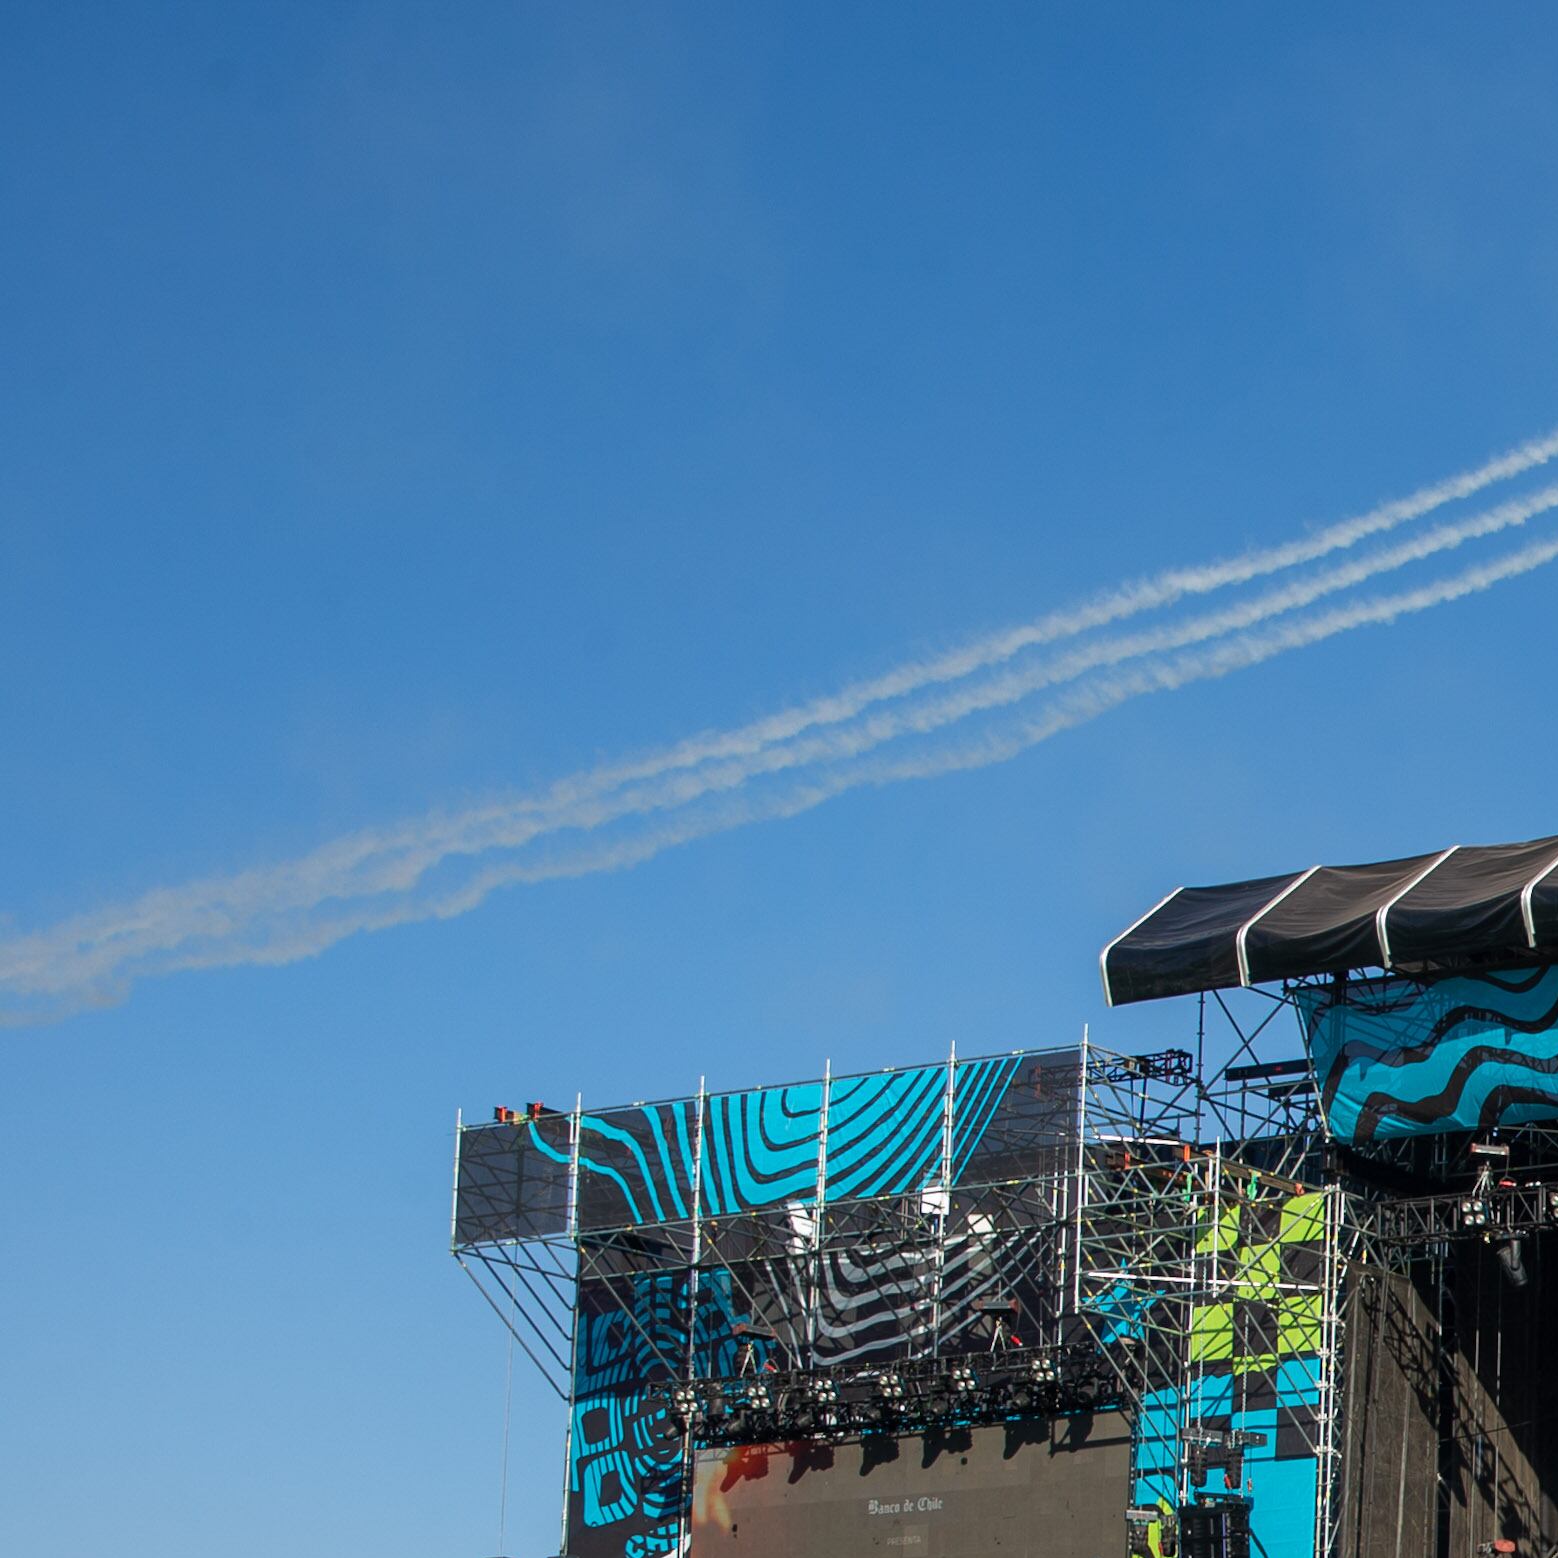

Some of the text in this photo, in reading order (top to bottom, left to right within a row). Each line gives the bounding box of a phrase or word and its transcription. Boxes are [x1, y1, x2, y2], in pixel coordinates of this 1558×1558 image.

[868, 1497, 943, 1515] Banco de Chile
[887, 1535, 922, 1546] PRESENTA
